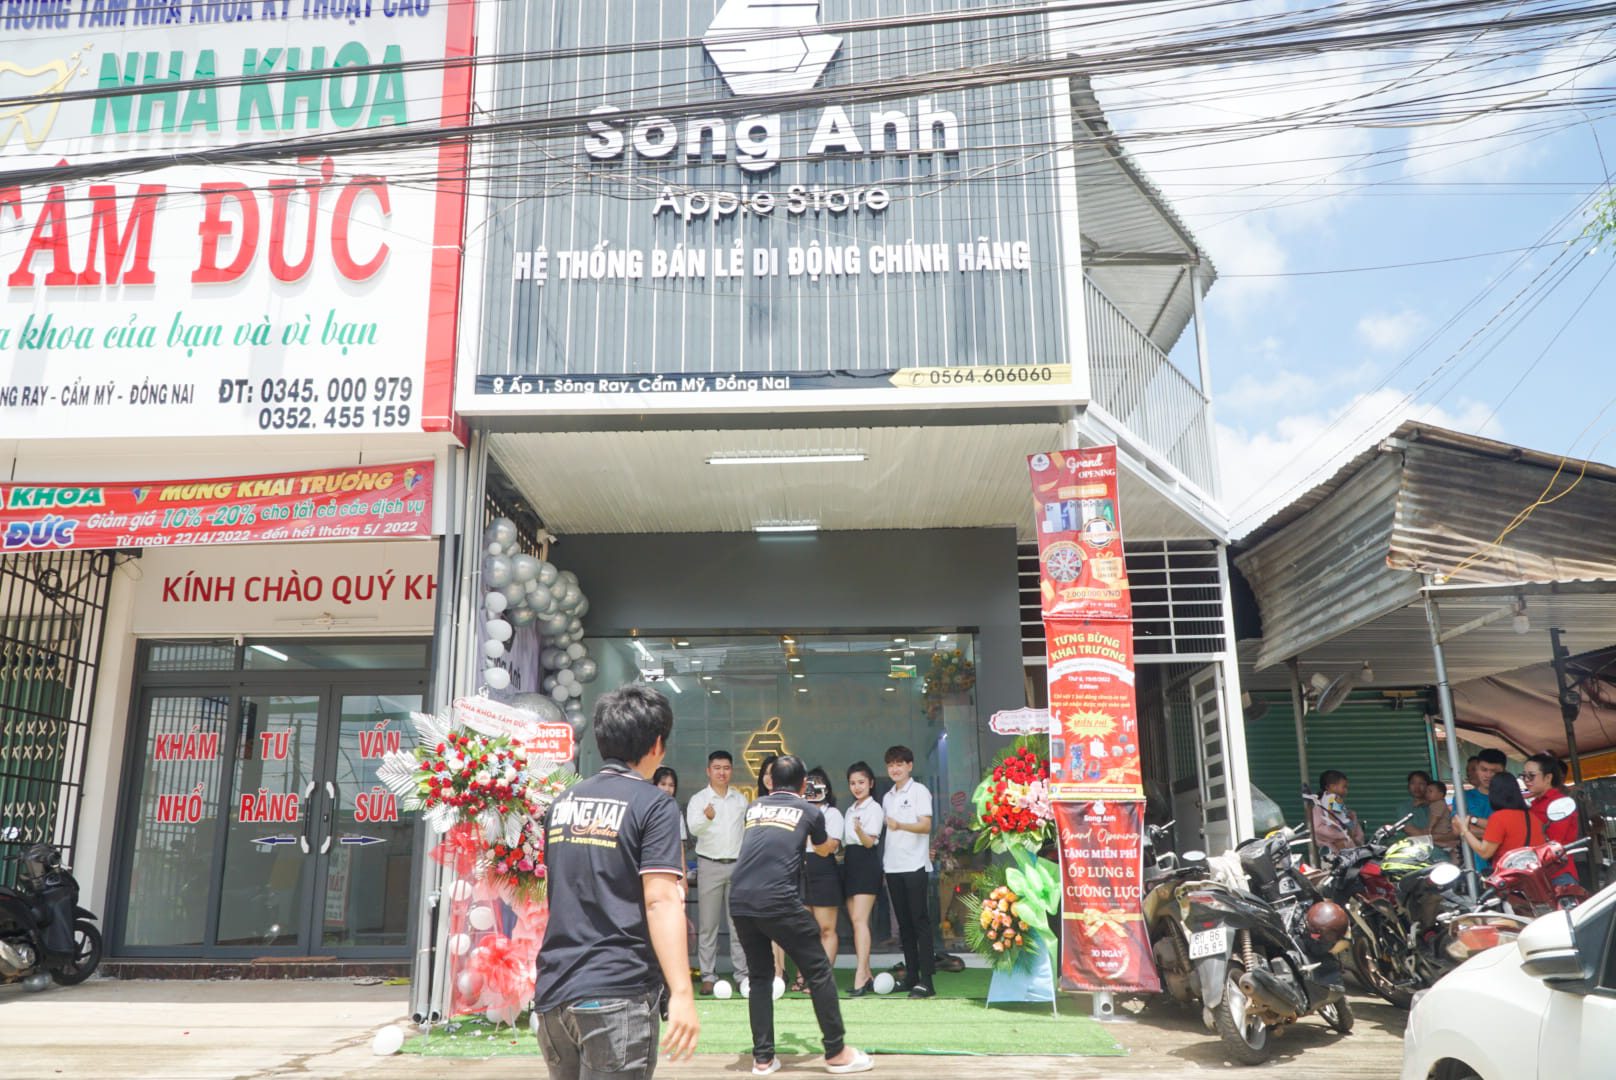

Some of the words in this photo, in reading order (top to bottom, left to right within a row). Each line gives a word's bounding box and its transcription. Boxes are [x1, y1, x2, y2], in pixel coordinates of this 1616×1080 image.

[92, 48, 220, 135] NHA
[236, 41, 408, 132] KHOA
[807, 98, 960, 155] Anh
[652, 184, 775, 222] Apple
[787, 184, 891, 214] Store
[514, 246, 548, 287] HỆ
[557, 240, 644, 280] THỐNG
[651, 243, 706, 278] BÁN
[715, 238, 745, 277] LẺ
[753, 248, 779, 277] DI
[788, 240, 861, 282] ĐỘNG
[869, 239, 950, 274] CHÍNH
[958, 236, 1032, 272] HÃNG
[18, 314, 94, 350] khoa
[103, 313, 157, 349] của
[167, 311, 225, 358] bạn
[233, 315, 272, 346] và
[281, 314, 312, 346] vì
[321, 309, 379, 355] bạn
[218, 379, 253, 404] ĐT:
[261, 378, 319, 403] 0345.
[327, 377, 367, 402] 000
[374, 377, 412, 402] 979
[508, 375, 532, 393] Ấp
[553, 378, 596, 393] Sông
[599, 380, 634, 393] Ray,
[638, 375, 677, 391] Cẩm
[762, 377, 790, 389] Nai
[929, 367, 1052, 384] 0564.606060
[21, 385, 48, 406] RAY
[61, 377, 90, 406] CẨM
[171, 384, 194, 404] NAI
[259, 407, 316, 429] 0352.
[324, 406, 364, 428] 455
[372, 405, 411, 427] 159
[8, 486, 104, 509] KHOA
[237, 479, 296, 498] KHAI
[4, 513, 80, 548] ĐỨC
[87, 510, 127, 529] Giảm
[128, 510, 156, 532] giá
[161, 507, 204, 528] 10%
[261, 504, 290, 520] cho
[293, 498, 314, 519] tất
[317, 499, 337, 518] cả
[340, 500, 368, 516] các
[371, 498, 403, 519] dịch
[407, 499, 425, 517] vụ
[116, 535, 134, 546] Từ
[174, 530, 250, 545] 22/4/2022
[261, 526, 288, 540] đến
[292, 524, 315, 538] hết
[319, 523, 359, 537] tháng
[364, 523, 381, 535] 5/
[383, 521, 418, 534] 2022
[162, 570, 236, 602] KÍNH
[244, 569, 323, 602] CHÀO
[332, 569, 396, 604] QUÝ
[1050, 646, 1077, 661] KHAI
[154, 725, 218, 760] KHÁM
[260, 729, 291, 760] TƯ
[358, 719, 401, 759] VẤN
[157, 783, 203, 823] NHỔ
[239, 788, 299, 822] RĂNG
[1126, 866, 1136, 878] &
